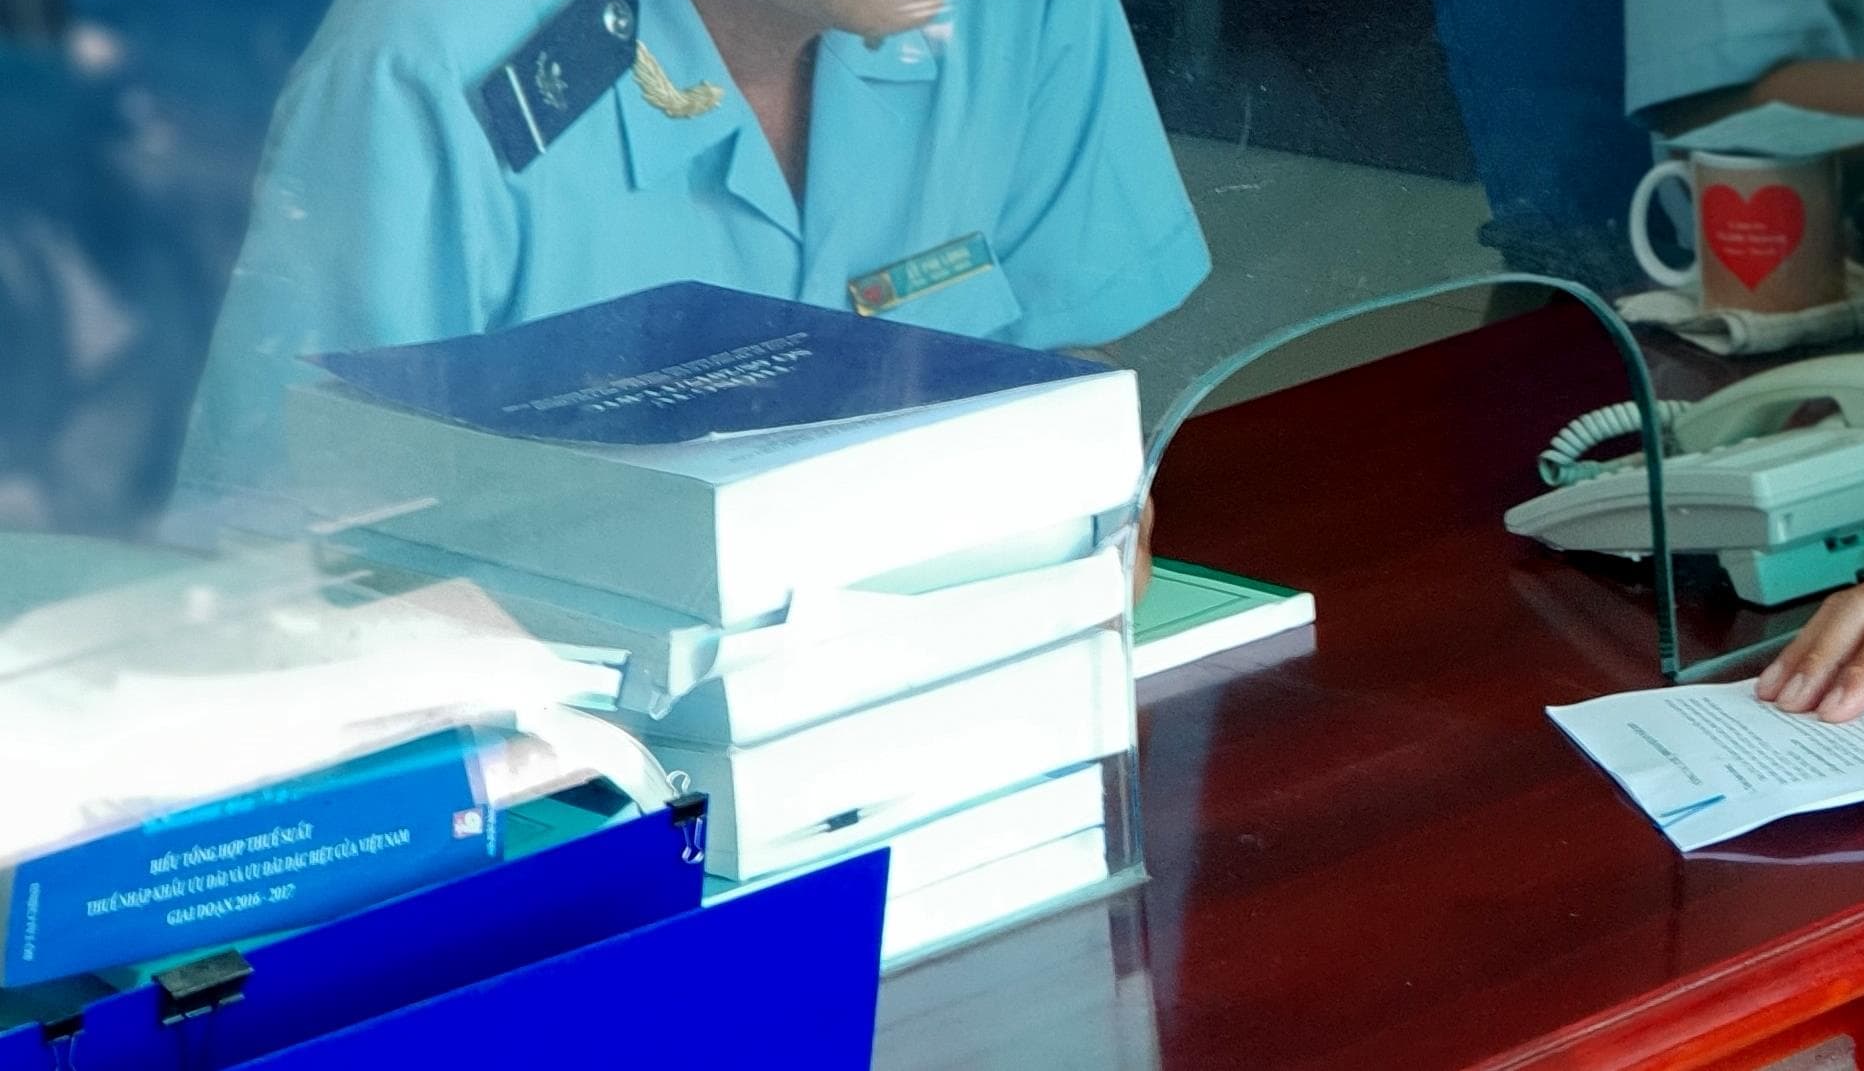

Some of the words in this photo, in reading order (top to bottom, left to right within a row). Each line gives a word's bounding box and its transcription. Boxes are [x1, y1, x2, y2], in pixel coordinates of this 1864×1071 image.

[246, 826, 280, 853] THUẾ
[358, 832, 384, 854] VIỆT
[384, 828, 411, 848] NAM
